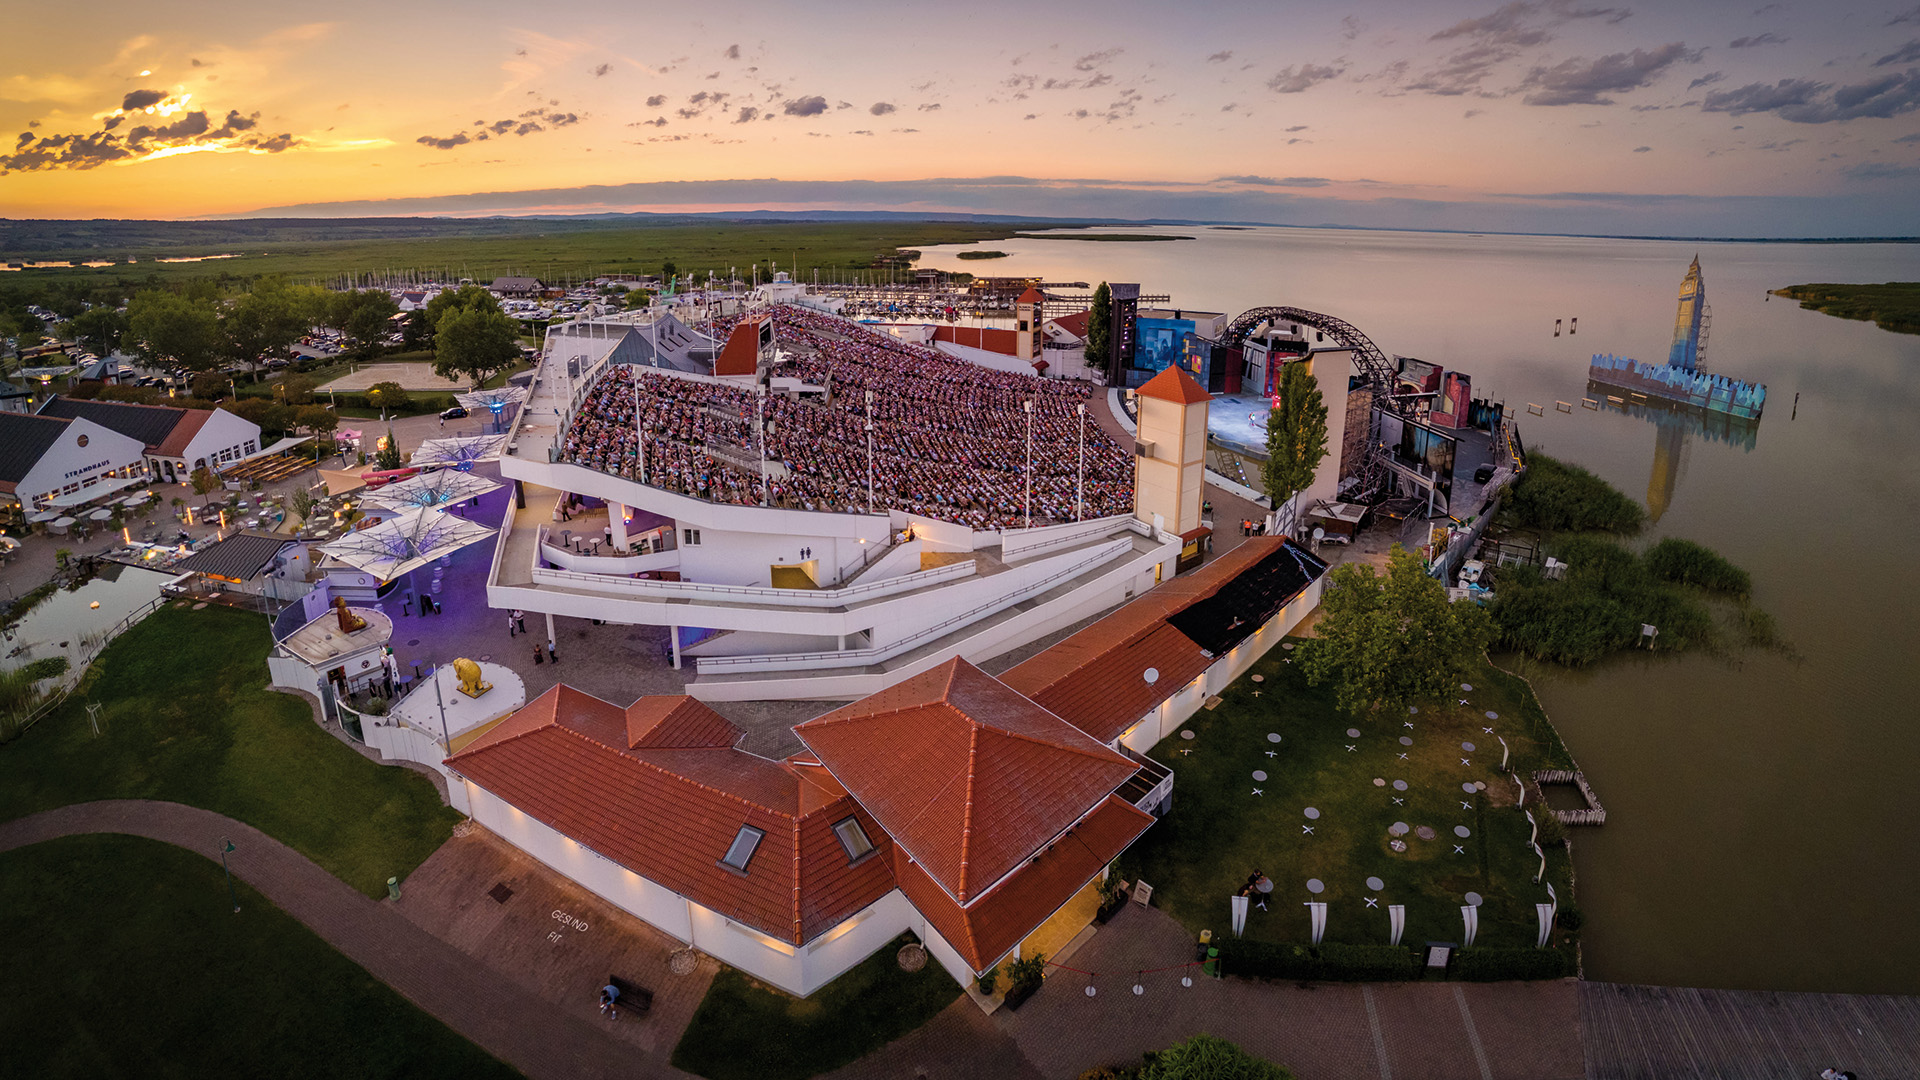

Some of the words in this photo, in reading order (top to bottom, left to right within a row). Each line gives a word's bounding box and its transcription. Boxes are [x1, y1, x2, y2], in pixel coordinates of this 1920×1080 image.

[65, 459, 110, 479] STRANDHAUS
[551, 909, 589, 932] GESUND
[546, 931, 563, 943] FIT
